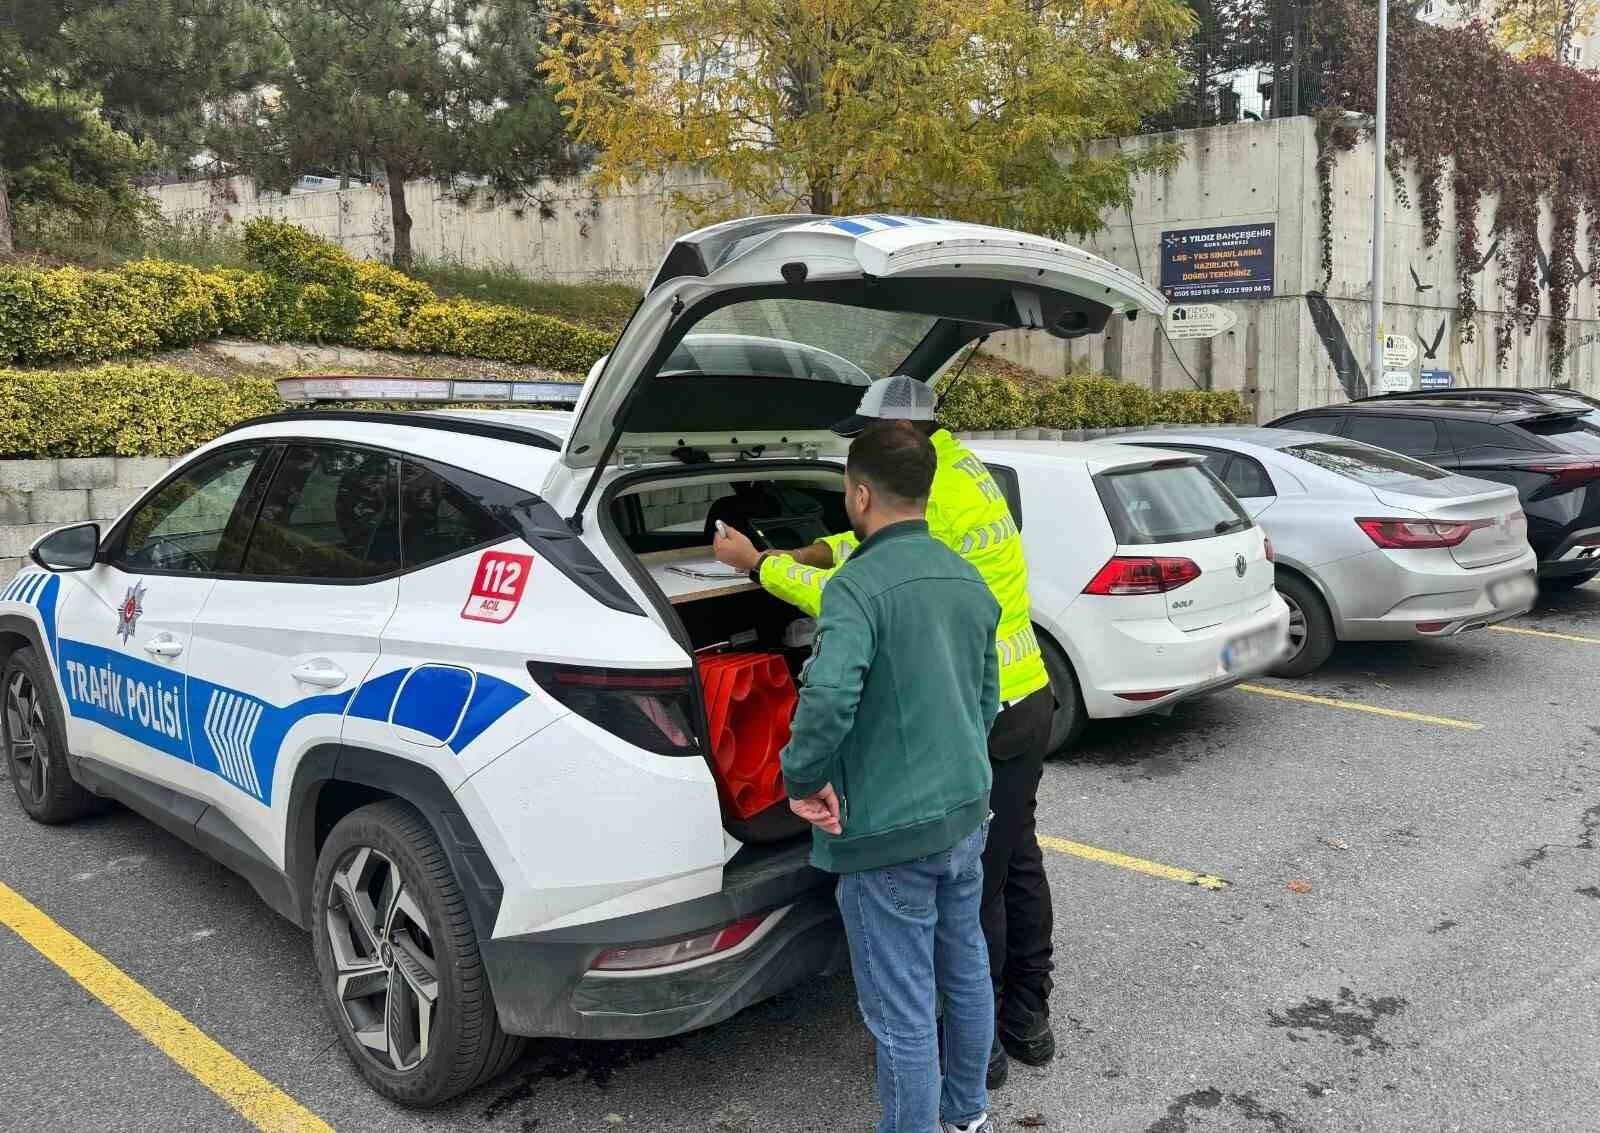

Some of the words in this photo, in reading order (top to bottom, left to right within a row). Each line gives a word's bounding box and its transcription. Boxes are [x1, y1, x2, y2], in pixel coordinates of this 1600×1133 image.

[1189, 234, 1215, 244] YILDIZ
[1216, 229, 1272, 241] BAHÇEŞEHİR
[481, 559, 522, 596] 112
[1172, 600, 1194, 609] GOLF
[66, 660, 125, 717] TRAFİK
[126, 677, 183, 741] POLİSİ
